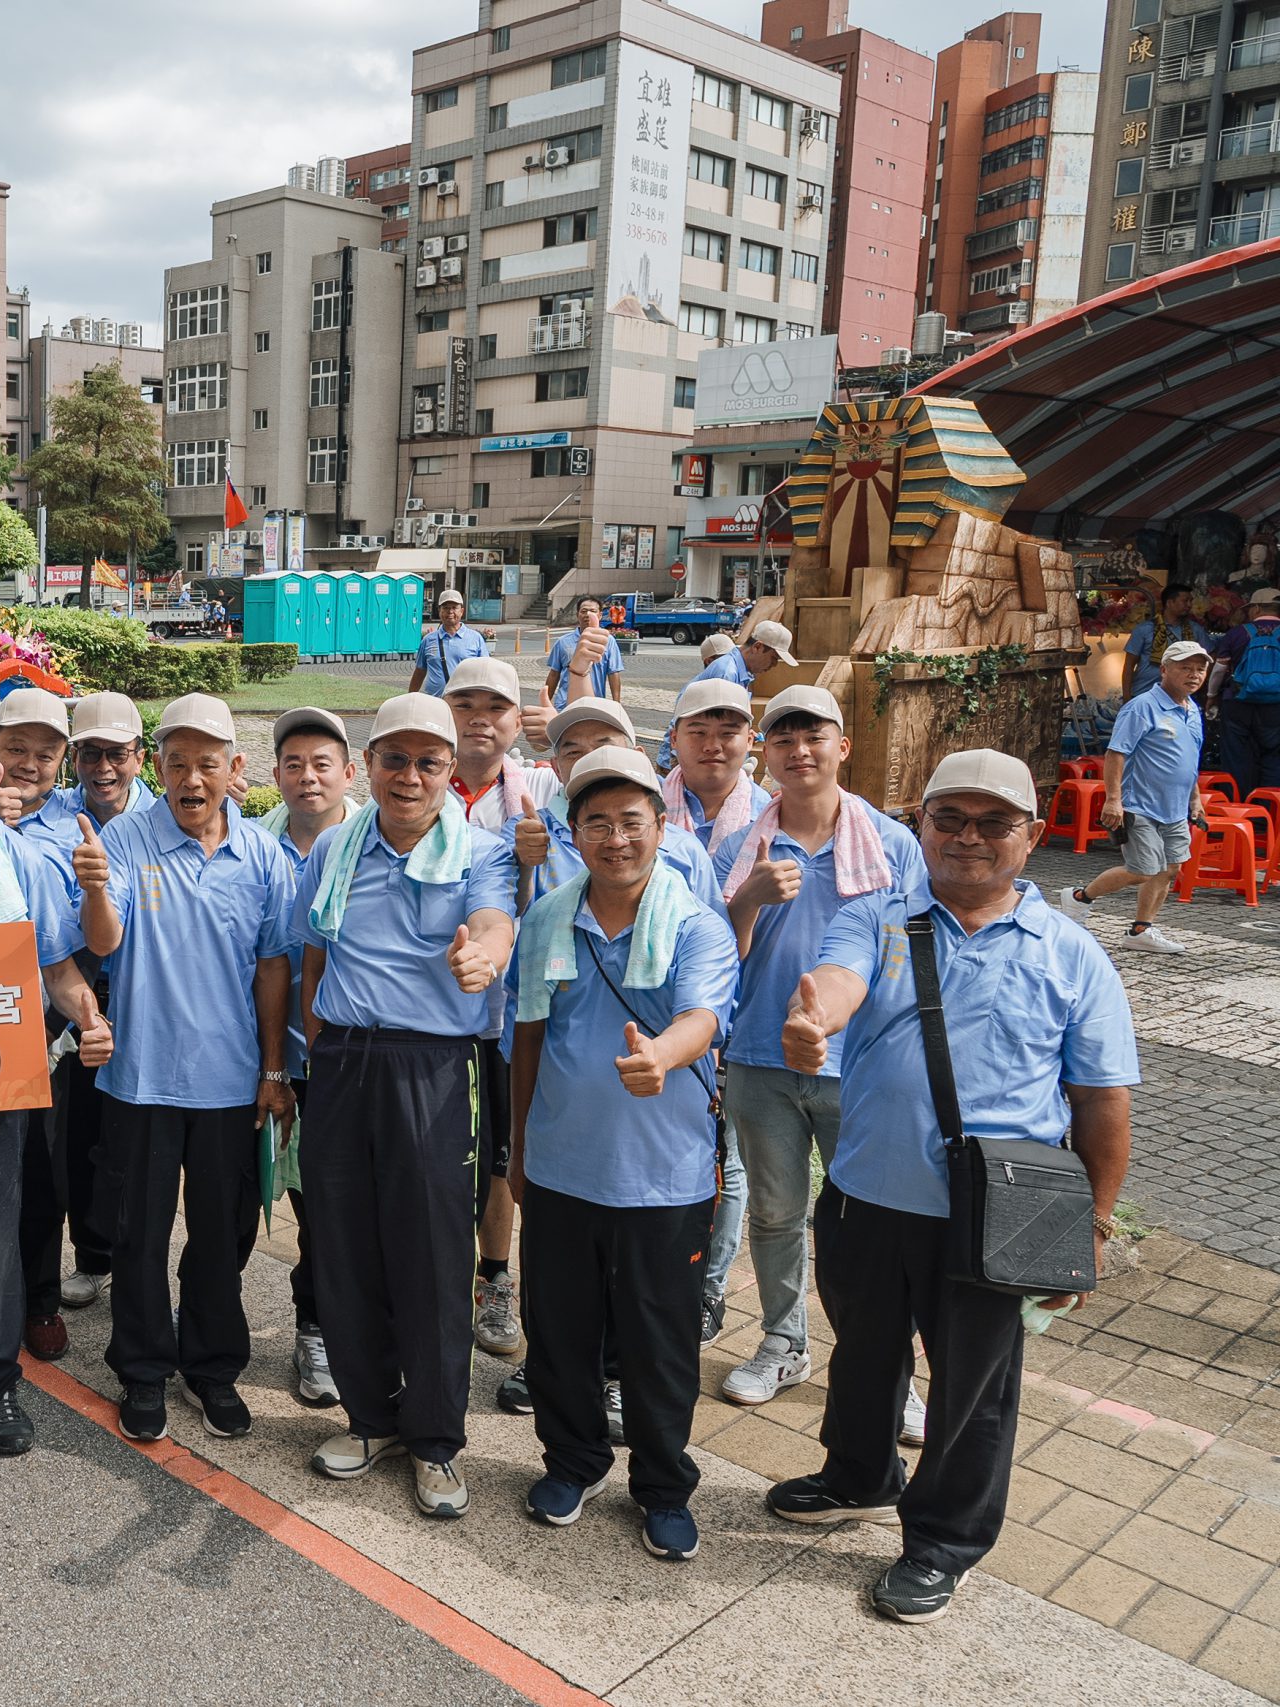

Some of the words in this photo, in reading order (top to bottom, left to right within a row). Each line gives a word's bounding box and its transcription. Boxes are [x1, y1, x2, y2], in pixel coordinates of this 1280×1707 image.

[637, 69, 672, 108] 宜雄
[626, 222, 668, 246] 338-5678
[724, 398, 752, 411] MOS
[752, 394, 798, 408] BURGER
[686, 487, 699, 495] 24H
[720, 524, 741, 532] MOS
